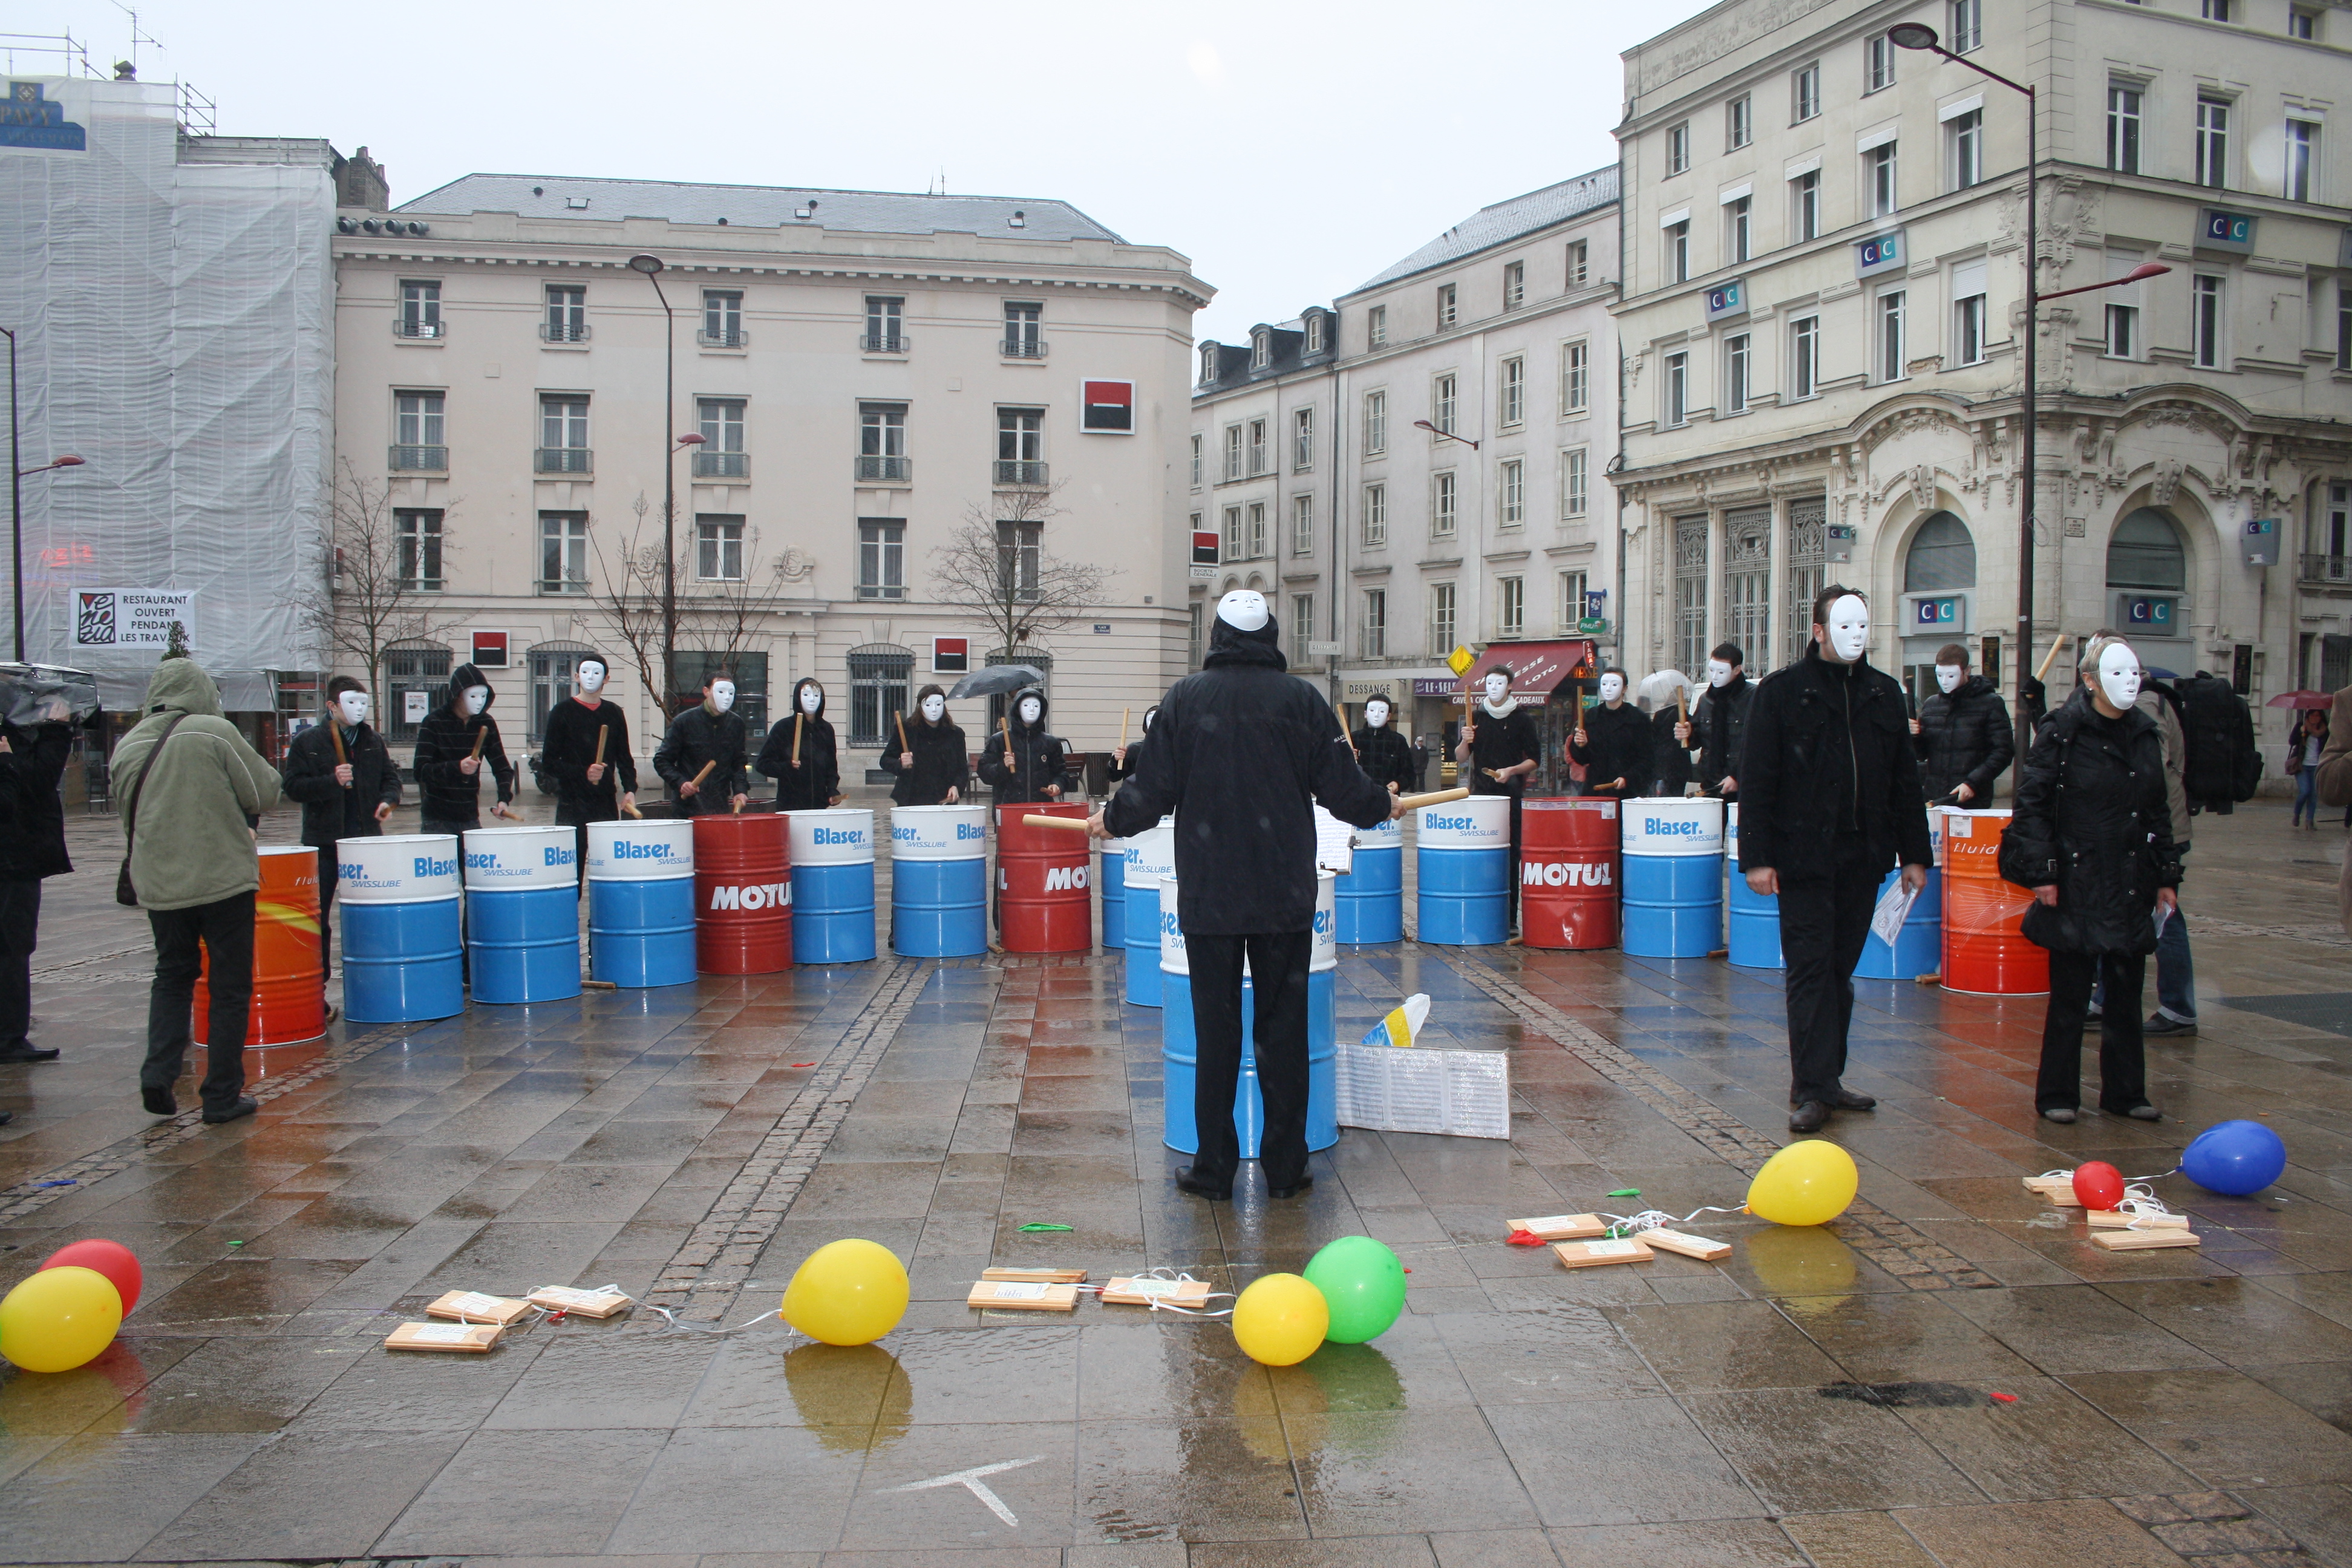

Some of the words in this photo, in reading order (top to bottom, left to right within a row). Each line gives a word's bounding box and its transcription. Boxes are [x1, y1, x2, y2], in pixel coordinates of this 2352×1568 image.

[2213, 218, 2245, 238] CIC
[1864, 241, 1892, 262] CIC
[1713, 289, 1735, 307] CIC
[2250, 523, 2269, 532] CIC
[123, 595, 188, 604] RESTAURANT
[135, 608, 175, 617] OUVERT
[1921, 603, 1951, 619] CIC
[2133, 603, 2165, 619] CIC
[121, 633, 137, 642] LES
[1459, 658, 1474, 675] PRESSE
[1524, 664, 1558, 687] LOTO
[1349, 684, 1390, 694] DESSANGE
[1426, 813, 1477, 829] Blaser.
[1645, 818, 1704, 835] Blaser.
[814, 828, 866, 844] Blaser.
[613, 841, 675, 859] Blaser.
[1953, 842, 1999, 855] fluid
[484, 868, 534, 877] SWISSLUBE
[1129, 864, 1173, 874] SWISSLUBE
[1523, 862, 1612, 887] MOTUL
[351, 880, 402, 888] SWISSLUBE
